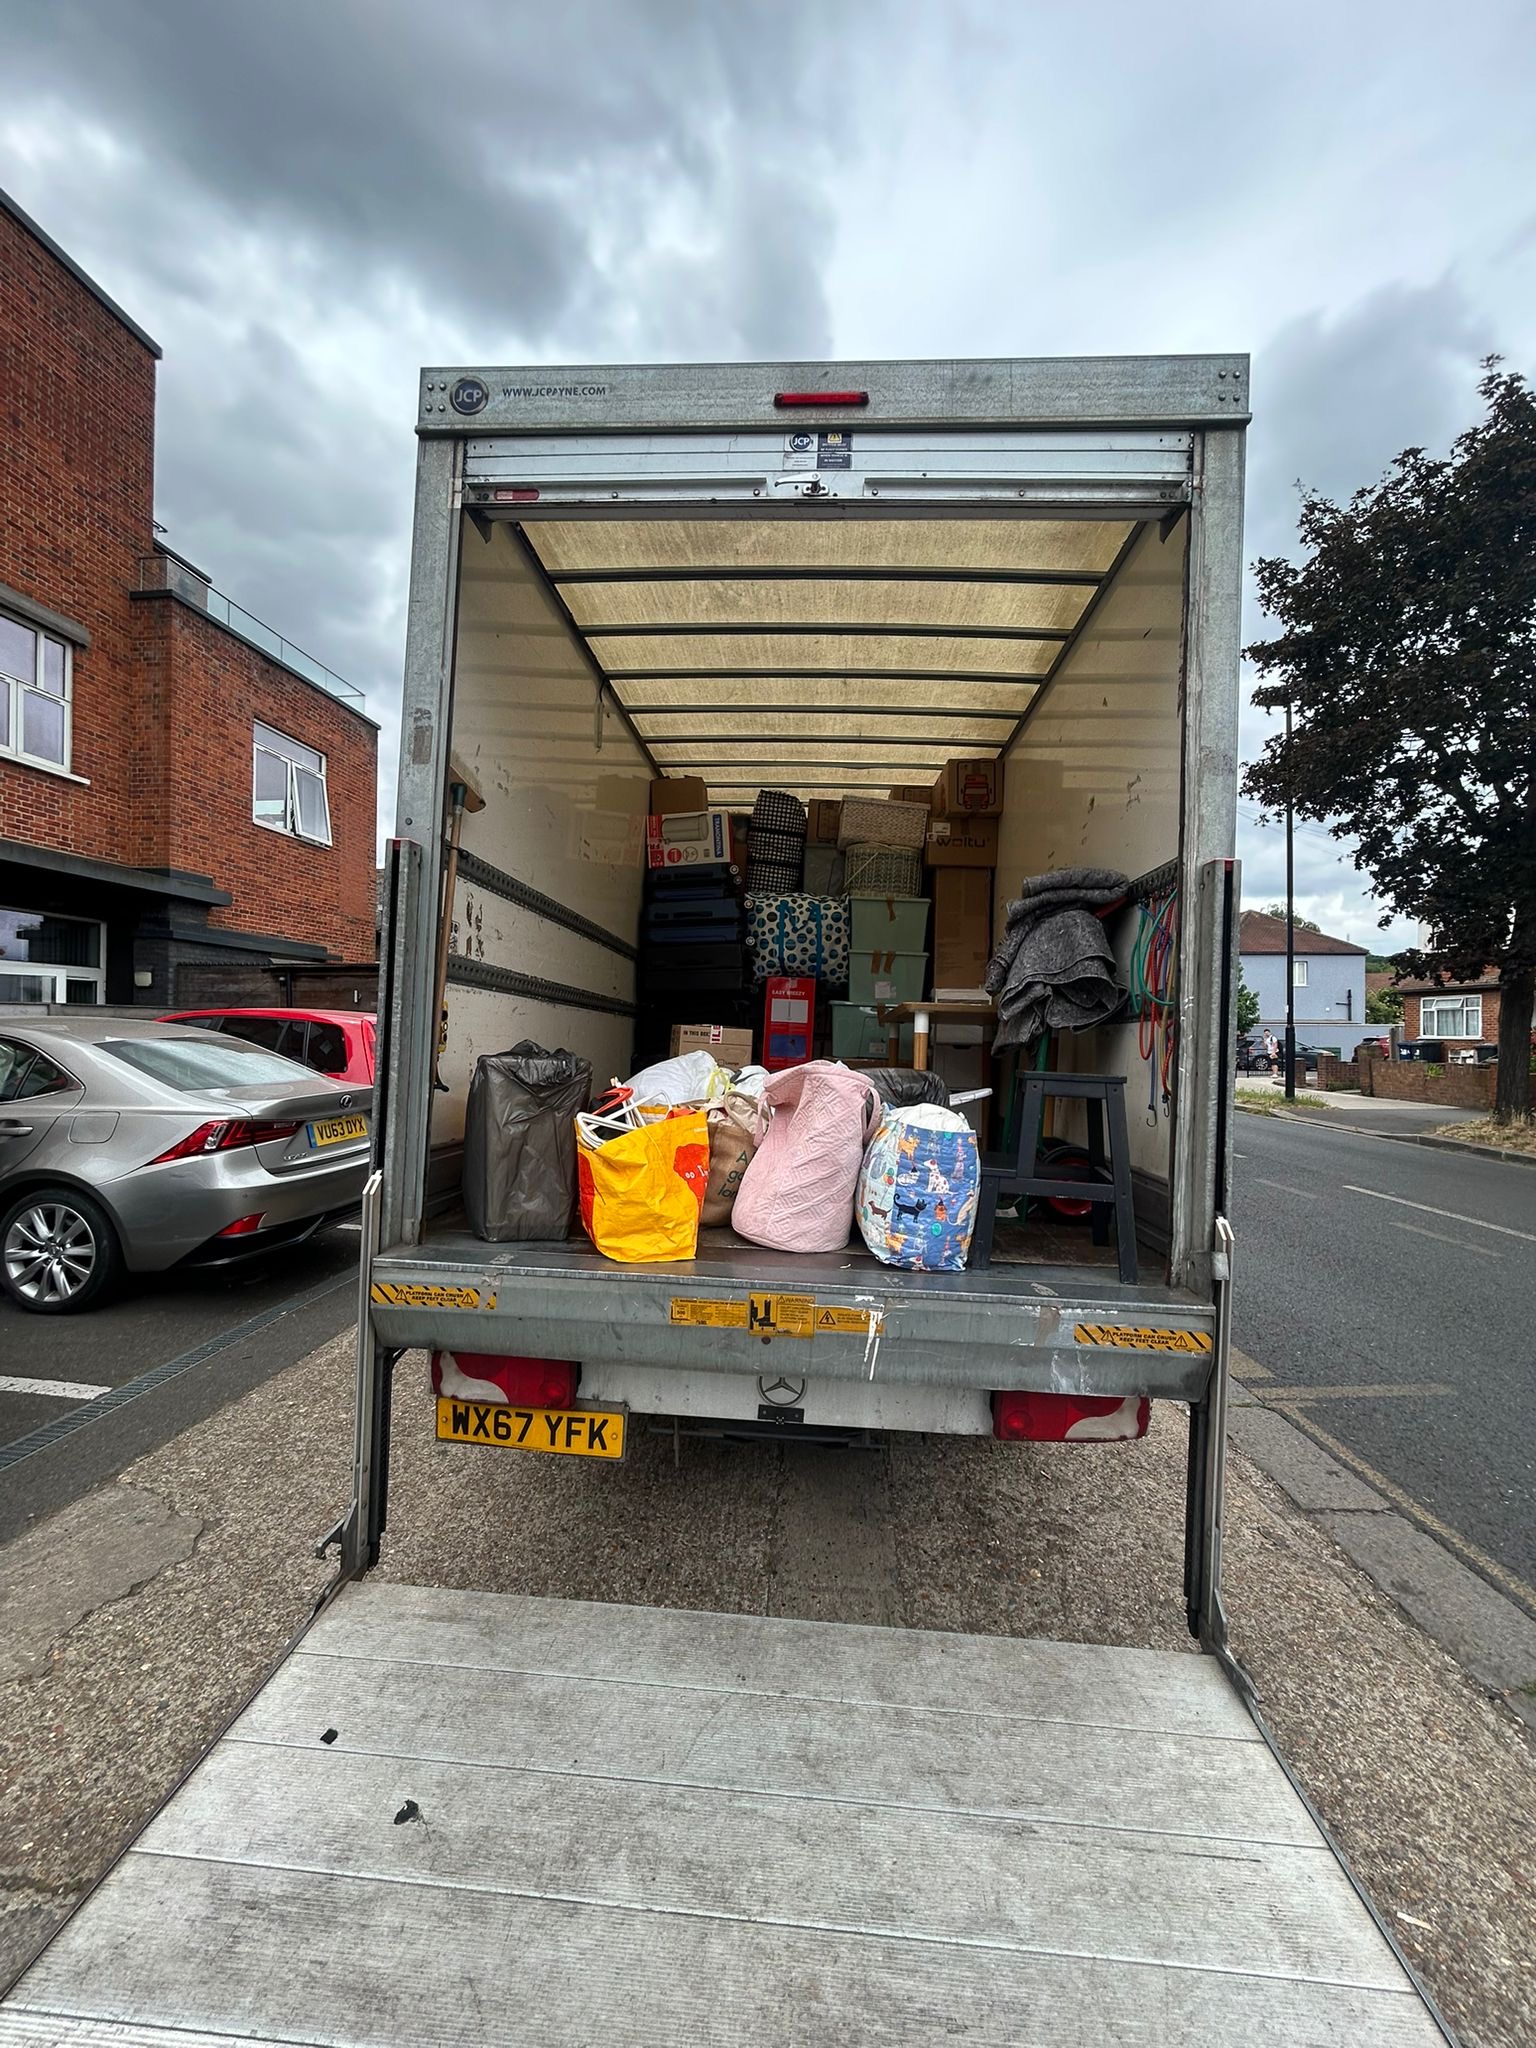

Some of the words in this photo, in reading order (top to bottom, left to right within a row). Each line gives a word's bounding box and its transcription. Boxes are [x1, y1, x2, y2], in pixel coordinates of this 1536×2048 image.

[456, 389, 483, 403] JCP
[502, 386, 606, 397] WWW.JCPAYNE.COM
[793, 437, 810, 446] JCP
[316, 1122, 345, 1140] VU63
[346, 1118, 365, 1135] DYX
[452, 1404, 534, 1443] WX67
[544, 1414, 609, 1451] YFK
